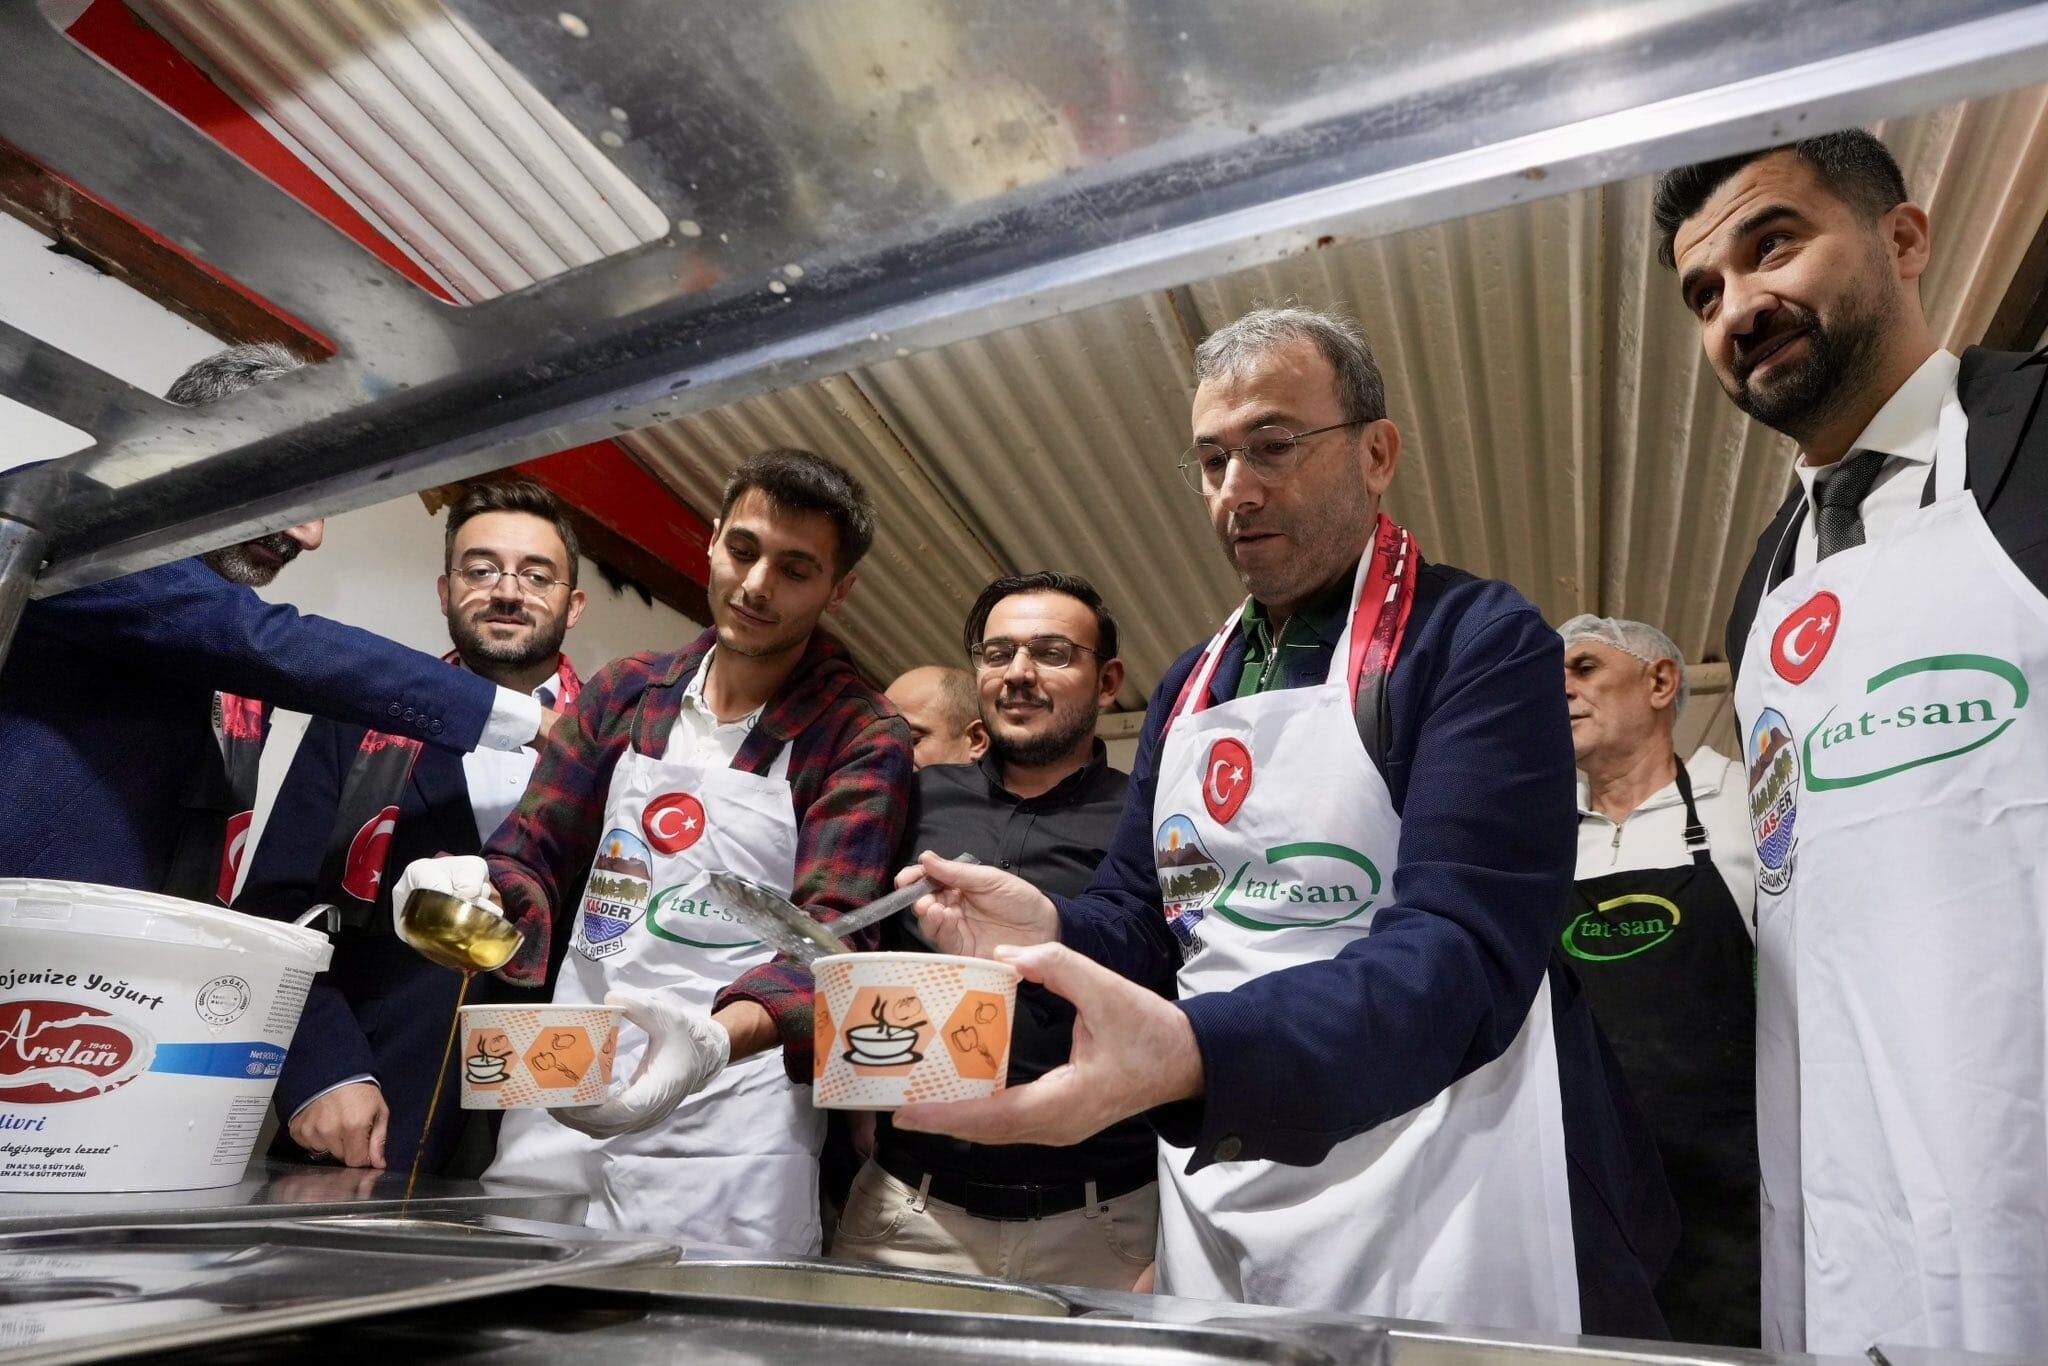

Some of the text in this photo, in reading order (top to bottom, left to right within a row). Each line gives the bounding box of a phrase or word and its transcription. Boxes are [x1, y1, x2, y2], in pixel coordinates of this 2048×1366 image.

[1821, 698, 1997, 750] tat-san
[1244, 877, 1359, 903] tat-san
[1580, 918, 1666, 938] tat-san
[84, 974, 164, 1010] Yoğurt
[0, 1009, 120, 1066] Arslan
[88, 1042, 112, 1050] 1940
[249, 1050, 263, 1059] Net
